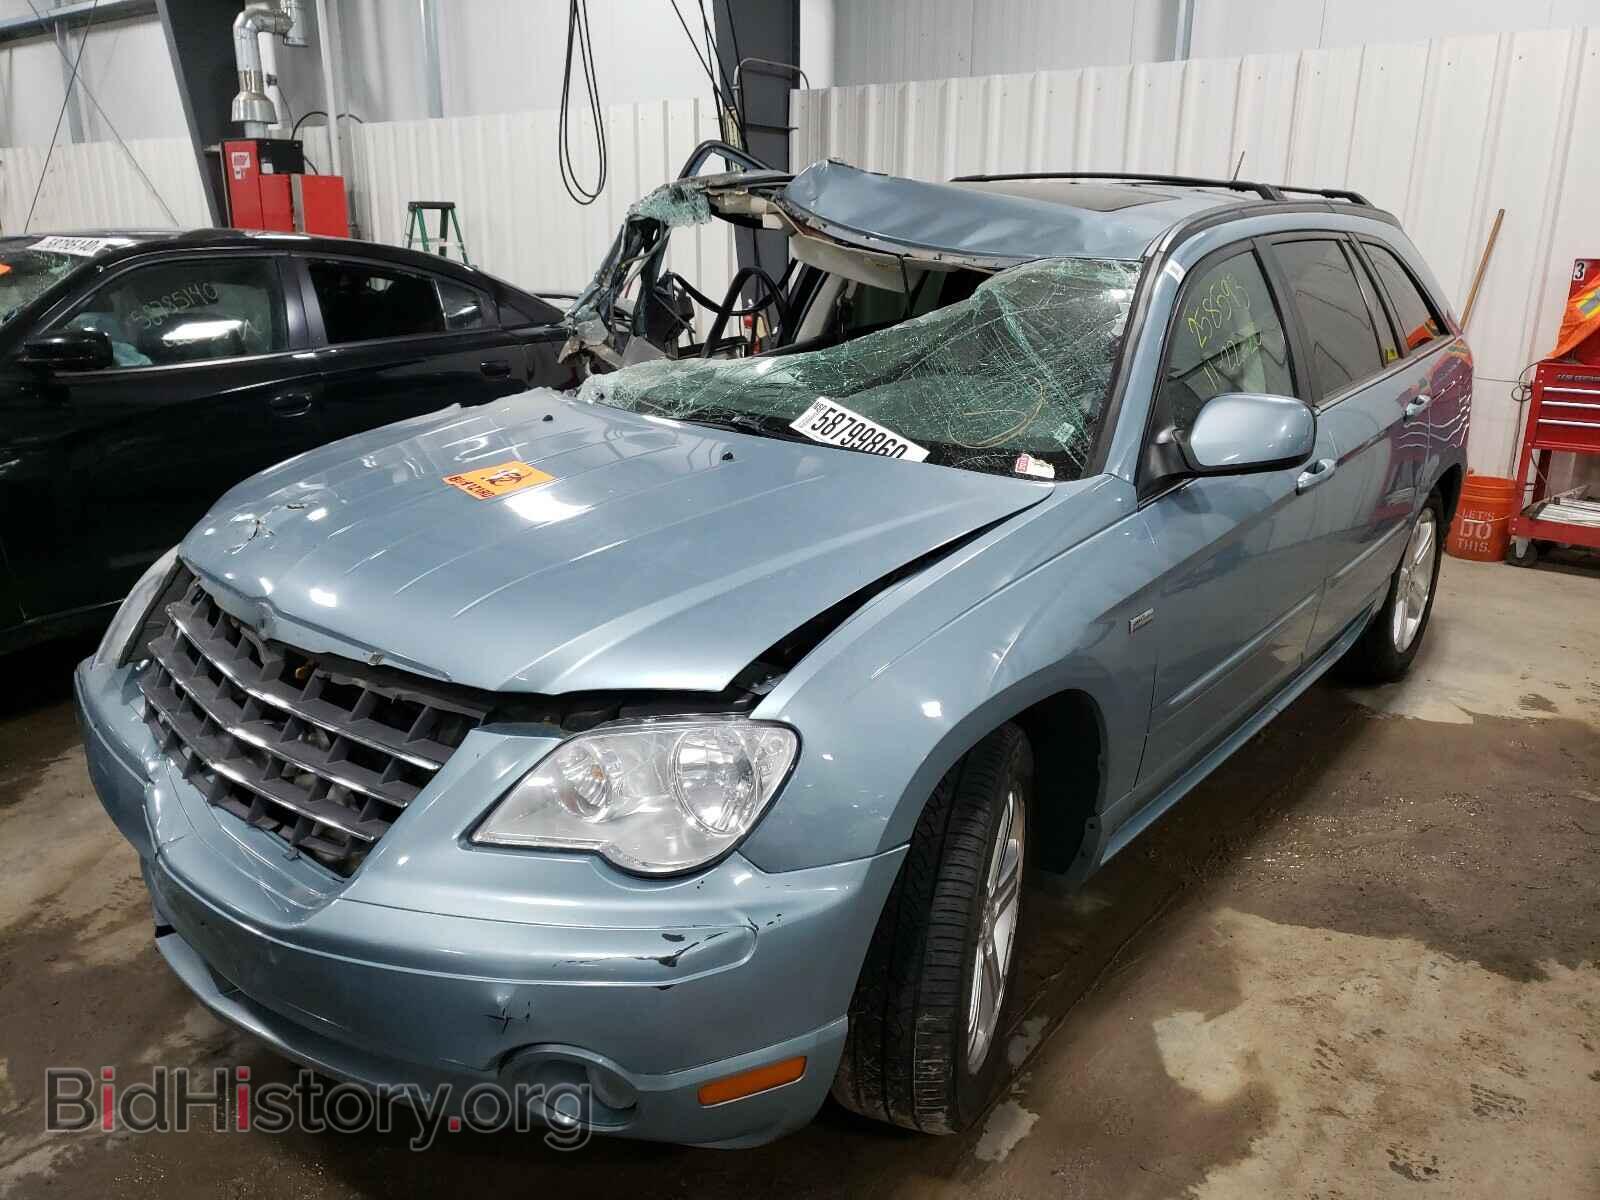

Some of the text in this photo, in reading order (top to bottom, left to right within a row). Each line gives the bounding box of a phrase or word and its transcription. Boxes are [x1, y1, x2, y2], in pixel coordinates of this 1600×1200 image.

[1574, 262, 1585, 279] 3
[811, 407, 908, 459] 58799860
[1464, 509, 1495, 520] LET'S
[1460, 520, 1492, 539] DO
